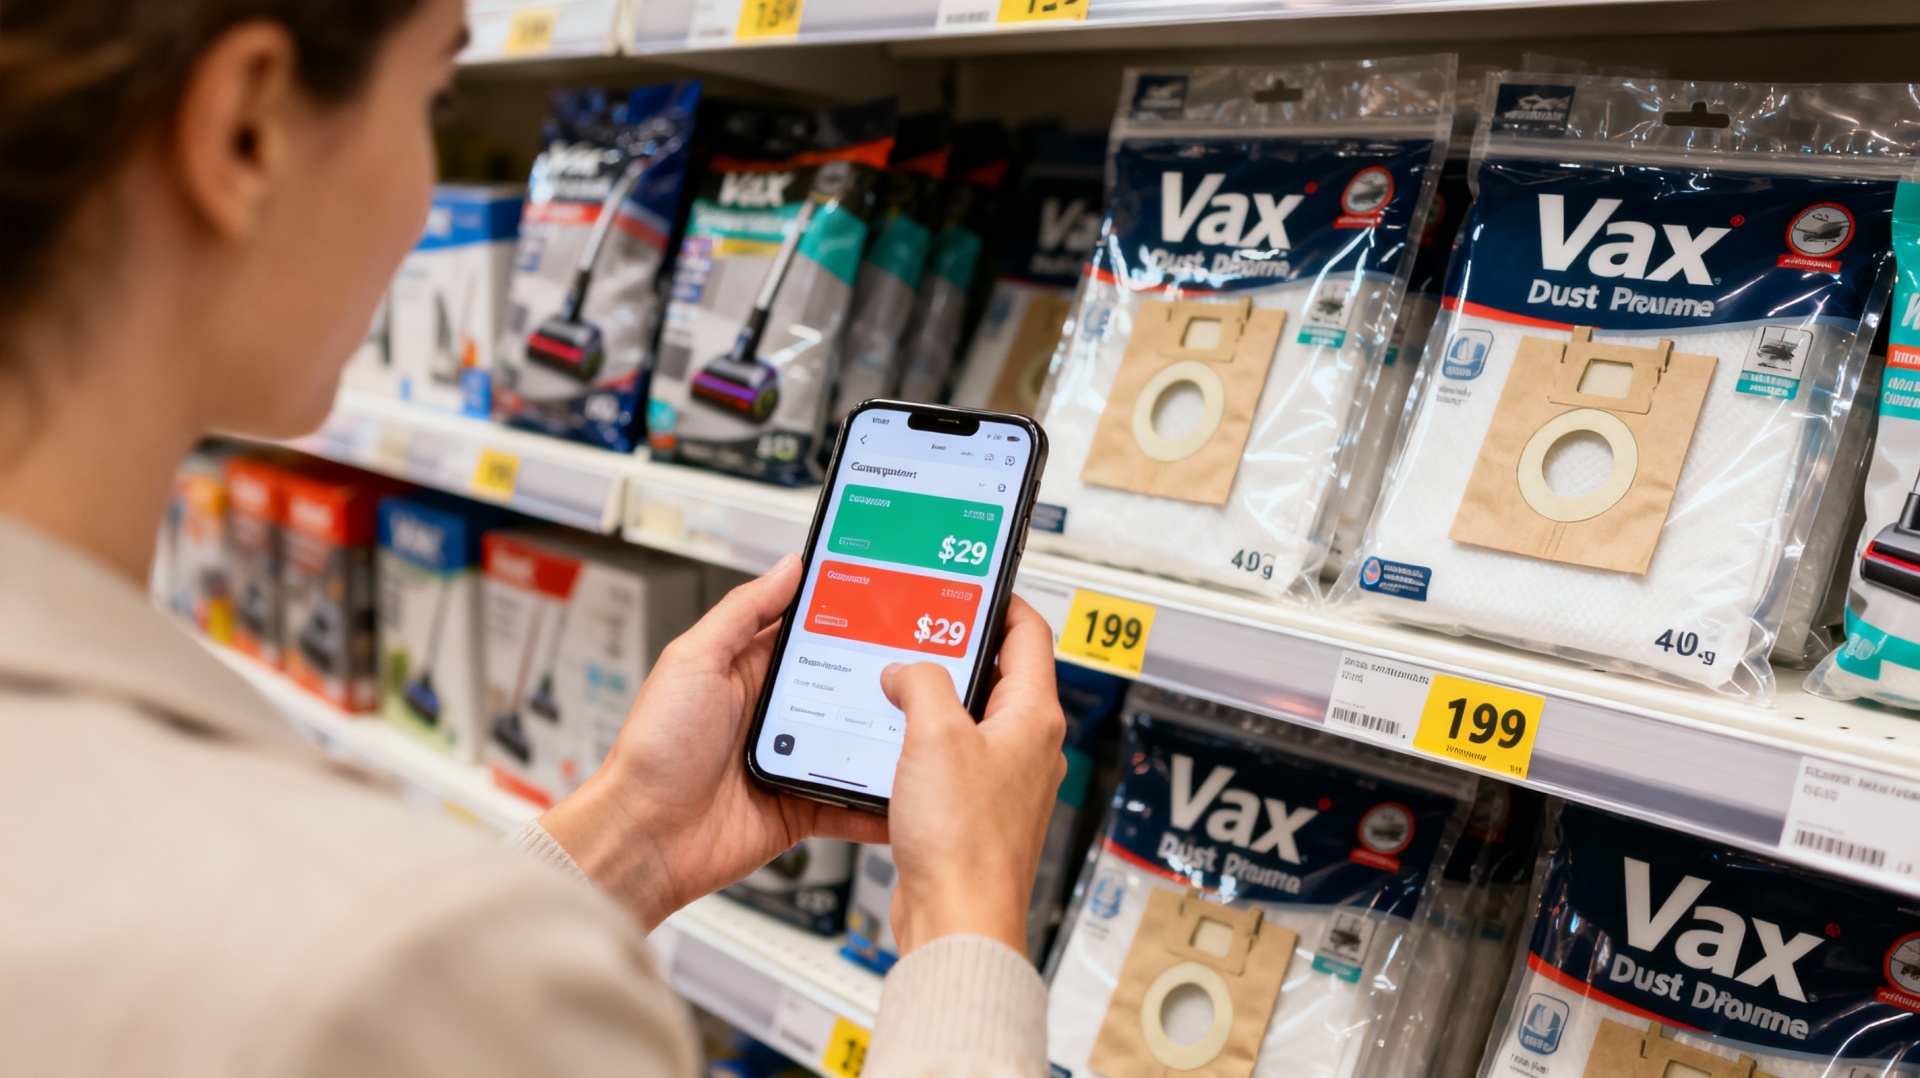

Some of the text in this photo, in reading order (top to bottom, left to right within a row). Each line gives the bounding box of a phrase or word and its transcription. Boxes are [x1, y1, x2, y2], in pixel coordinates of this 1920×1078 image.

[1040, 198, 1101, 251] Va
[1162, 171, 1305, 250] Vax
[1538, 194, 1732, 286] Vax
[1527, 279, 1600, 310] Dust
[938, 535, 987, 565] $29
[914, 613, 965, 646] $29
[1086, 610, 1142, 649] 199
[1448, 698, 1526, 749] 199
[1170, 753, 1319, 865] Vax
[1624, 857, 1826, 1004] Vax
[1609, 953, 1684, 1002] Dust
